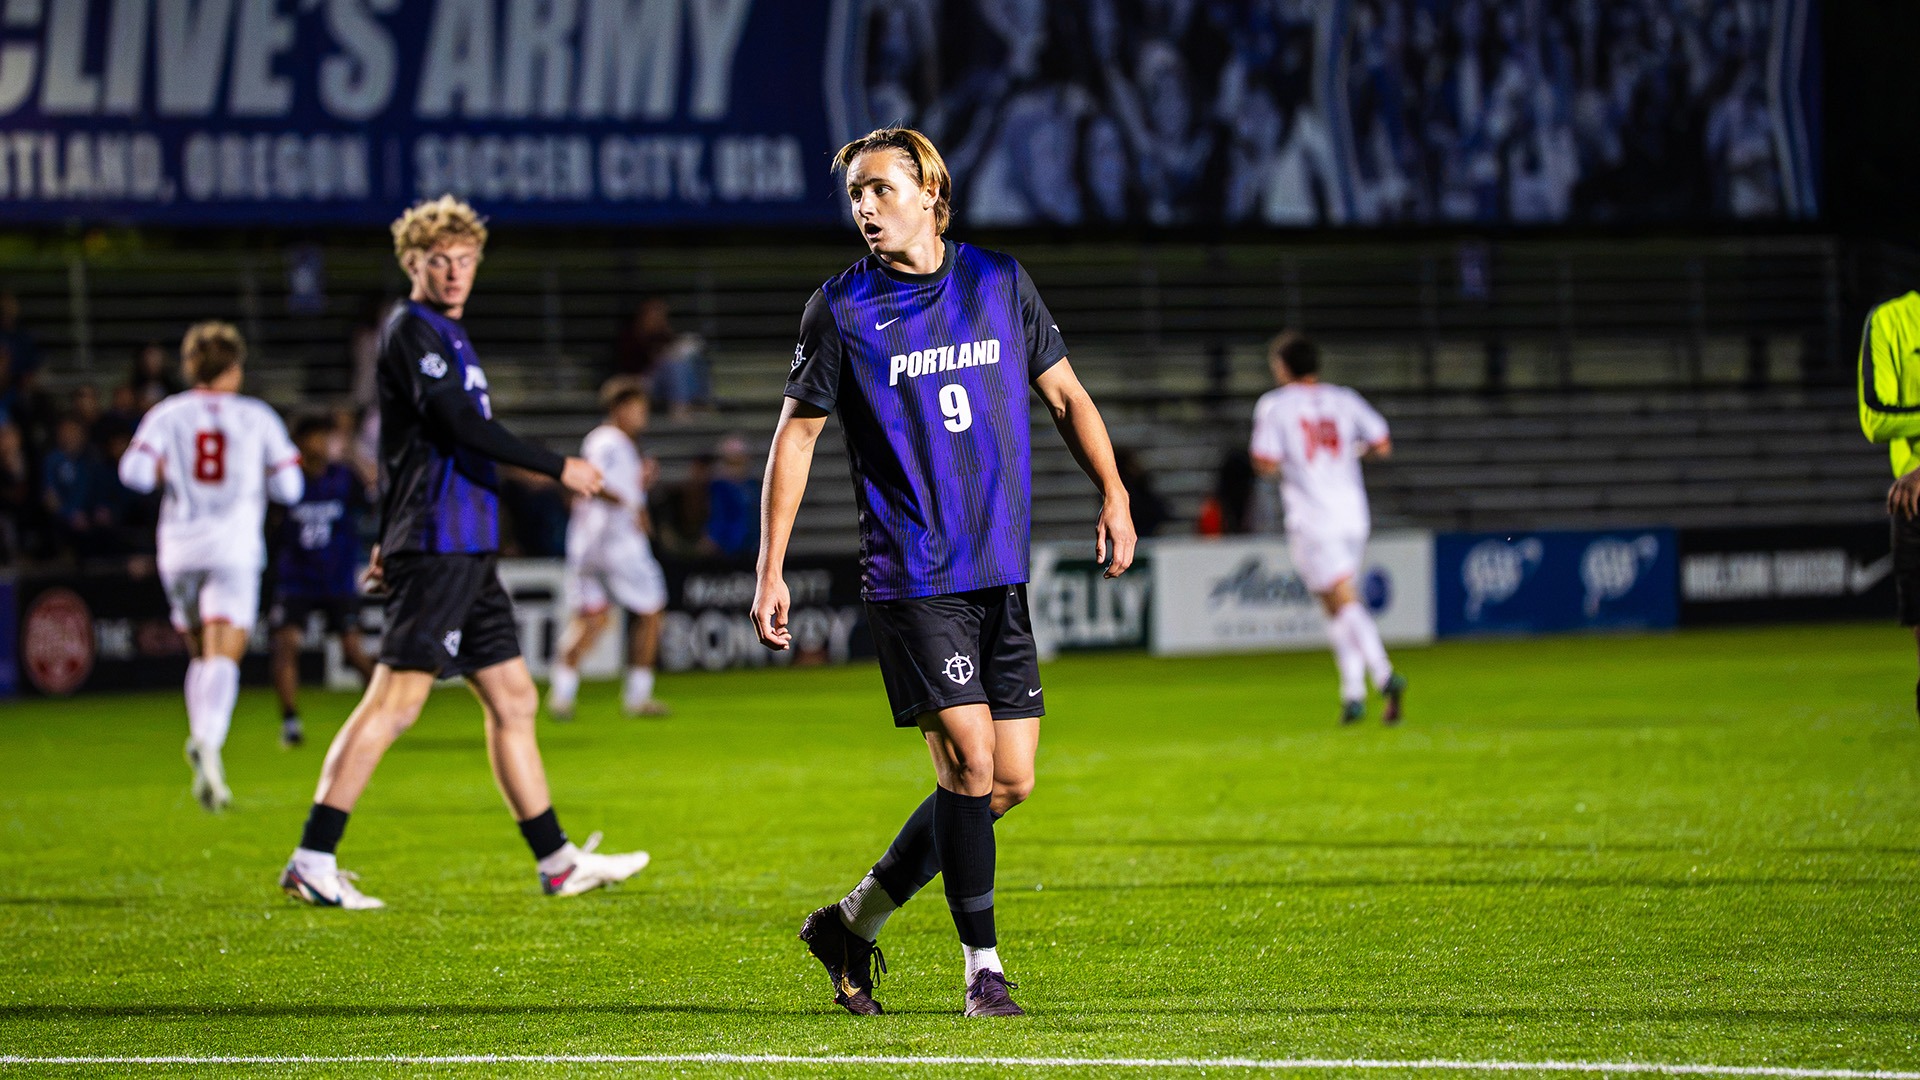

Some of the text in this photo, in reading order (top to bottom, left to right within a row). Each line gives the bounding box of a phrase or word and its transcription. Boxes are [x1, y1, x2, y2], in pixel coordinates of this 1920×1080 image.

[0, 0, 754, 120] LIVES ARMY
[184, 134, 371, 199] OREGON
[413, 135, 593, 199] SOCCER
[714, 136, 804, 199] USA
[889, 338, 1001, 387] PORTLAND
[937, 384, 974, 434] 9
[193, 430, 226, 483] 8
